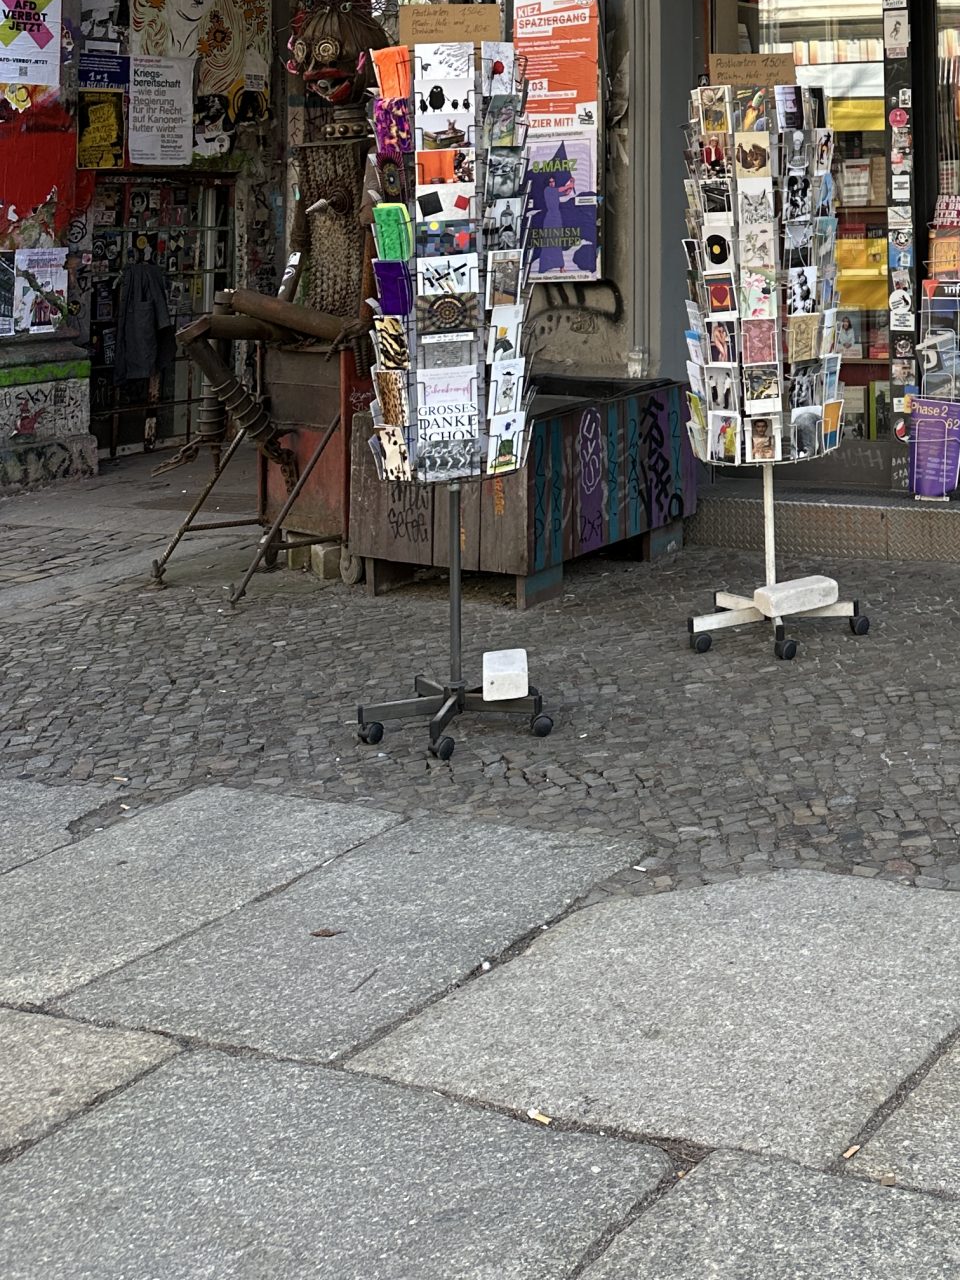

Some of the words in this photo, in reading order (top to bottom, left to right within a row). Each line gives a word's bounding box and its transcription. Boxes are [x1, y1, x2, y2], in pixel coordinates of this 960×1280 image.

[14, 0, 37, 11] AFD
[517, 3, 540, 18] KIEZ
[2, 9, 48, 22] VERBOT
[518, 12, 587, 30] SPAZIERGANG
[8, 22, 43, 33] JETZT
[133, 68, 163, 79] Kriegs-
[133, 79, 181, 89] bereitschaft
[153, 88, 167, 97] die
[132, 96, 175, 108] Regierung
[146, 106, 157, 115] ihr
[159, 106, 182, 115] Recht
[132, 115, 146, 124] auf
[147, 115, 186, 125] Kanonen-
[553, 117, 574, 128] MIT!
[156, 124, 177, 134] wirbt
[529, 227, 581, 239] EMINISM
[418, 402, 477, 417] GROSSES
[911, 401, 940, 417] Phase
[940, 405, 949, 417] 2
[419, 416, 477, 430] DANKE
[946, 418, 960, 431] 62
[419, 427, 477, 442] SCHÖN
